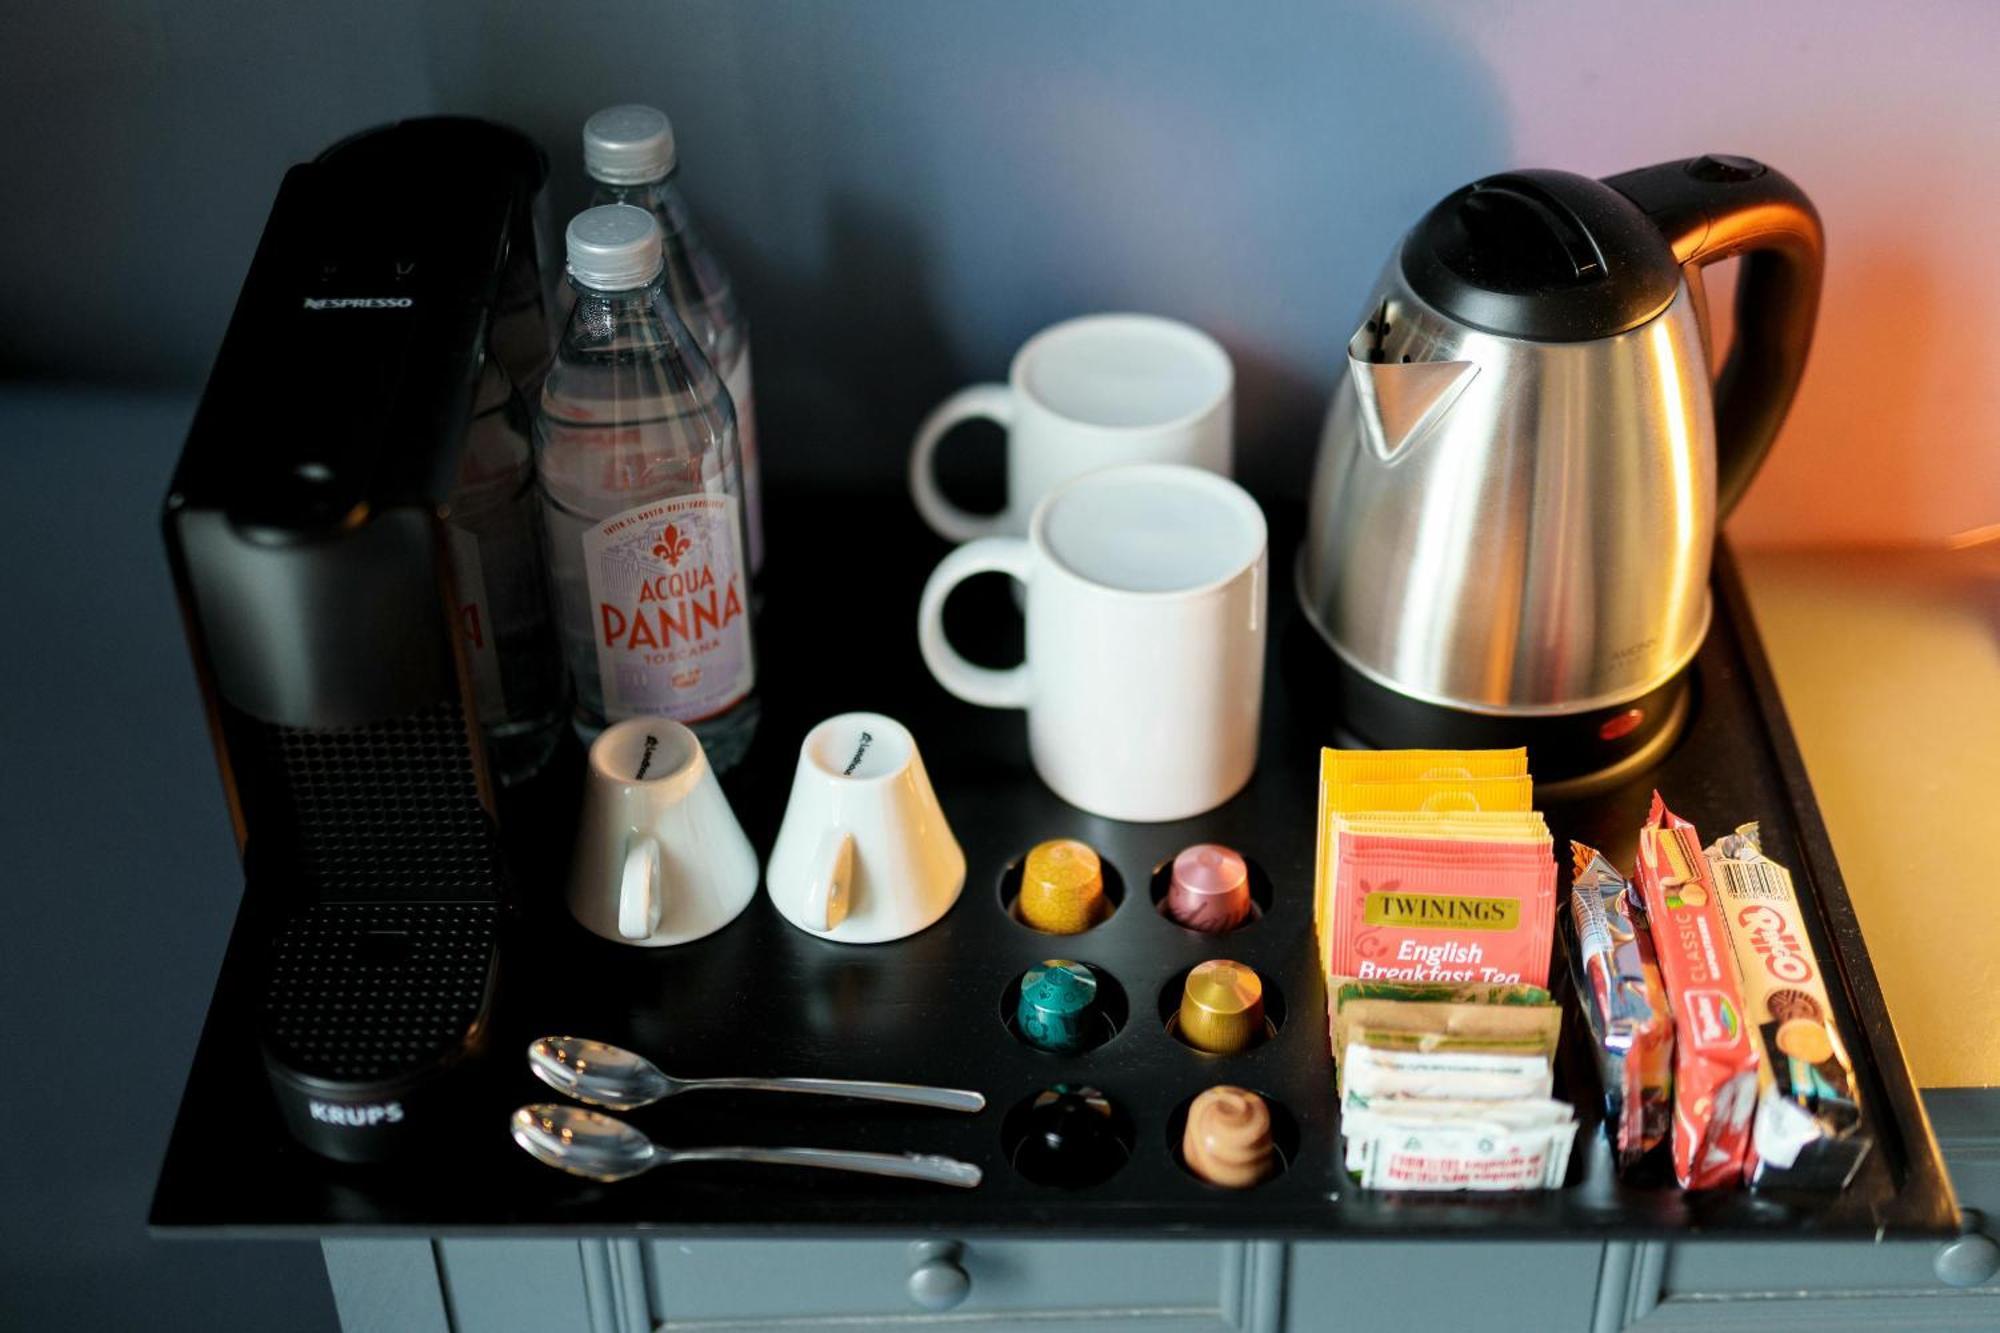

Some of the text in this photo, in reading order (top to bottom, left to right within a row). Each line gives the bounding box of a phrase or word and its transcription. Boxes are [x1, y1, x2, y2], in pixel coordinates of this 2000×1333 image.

[639, 563, 716, 604] ACQUA
[601, 582, 742, 651] PANNA
[1380, 896, 1505, 921] TWININGS
[1397, 939, 1484, 966] English
[1675, 912, 1707, 984] CLASSIC
[1359, 960, 1521, 985] Breakfast Tea
[309, 1101, 404, 1126] KRUPS
